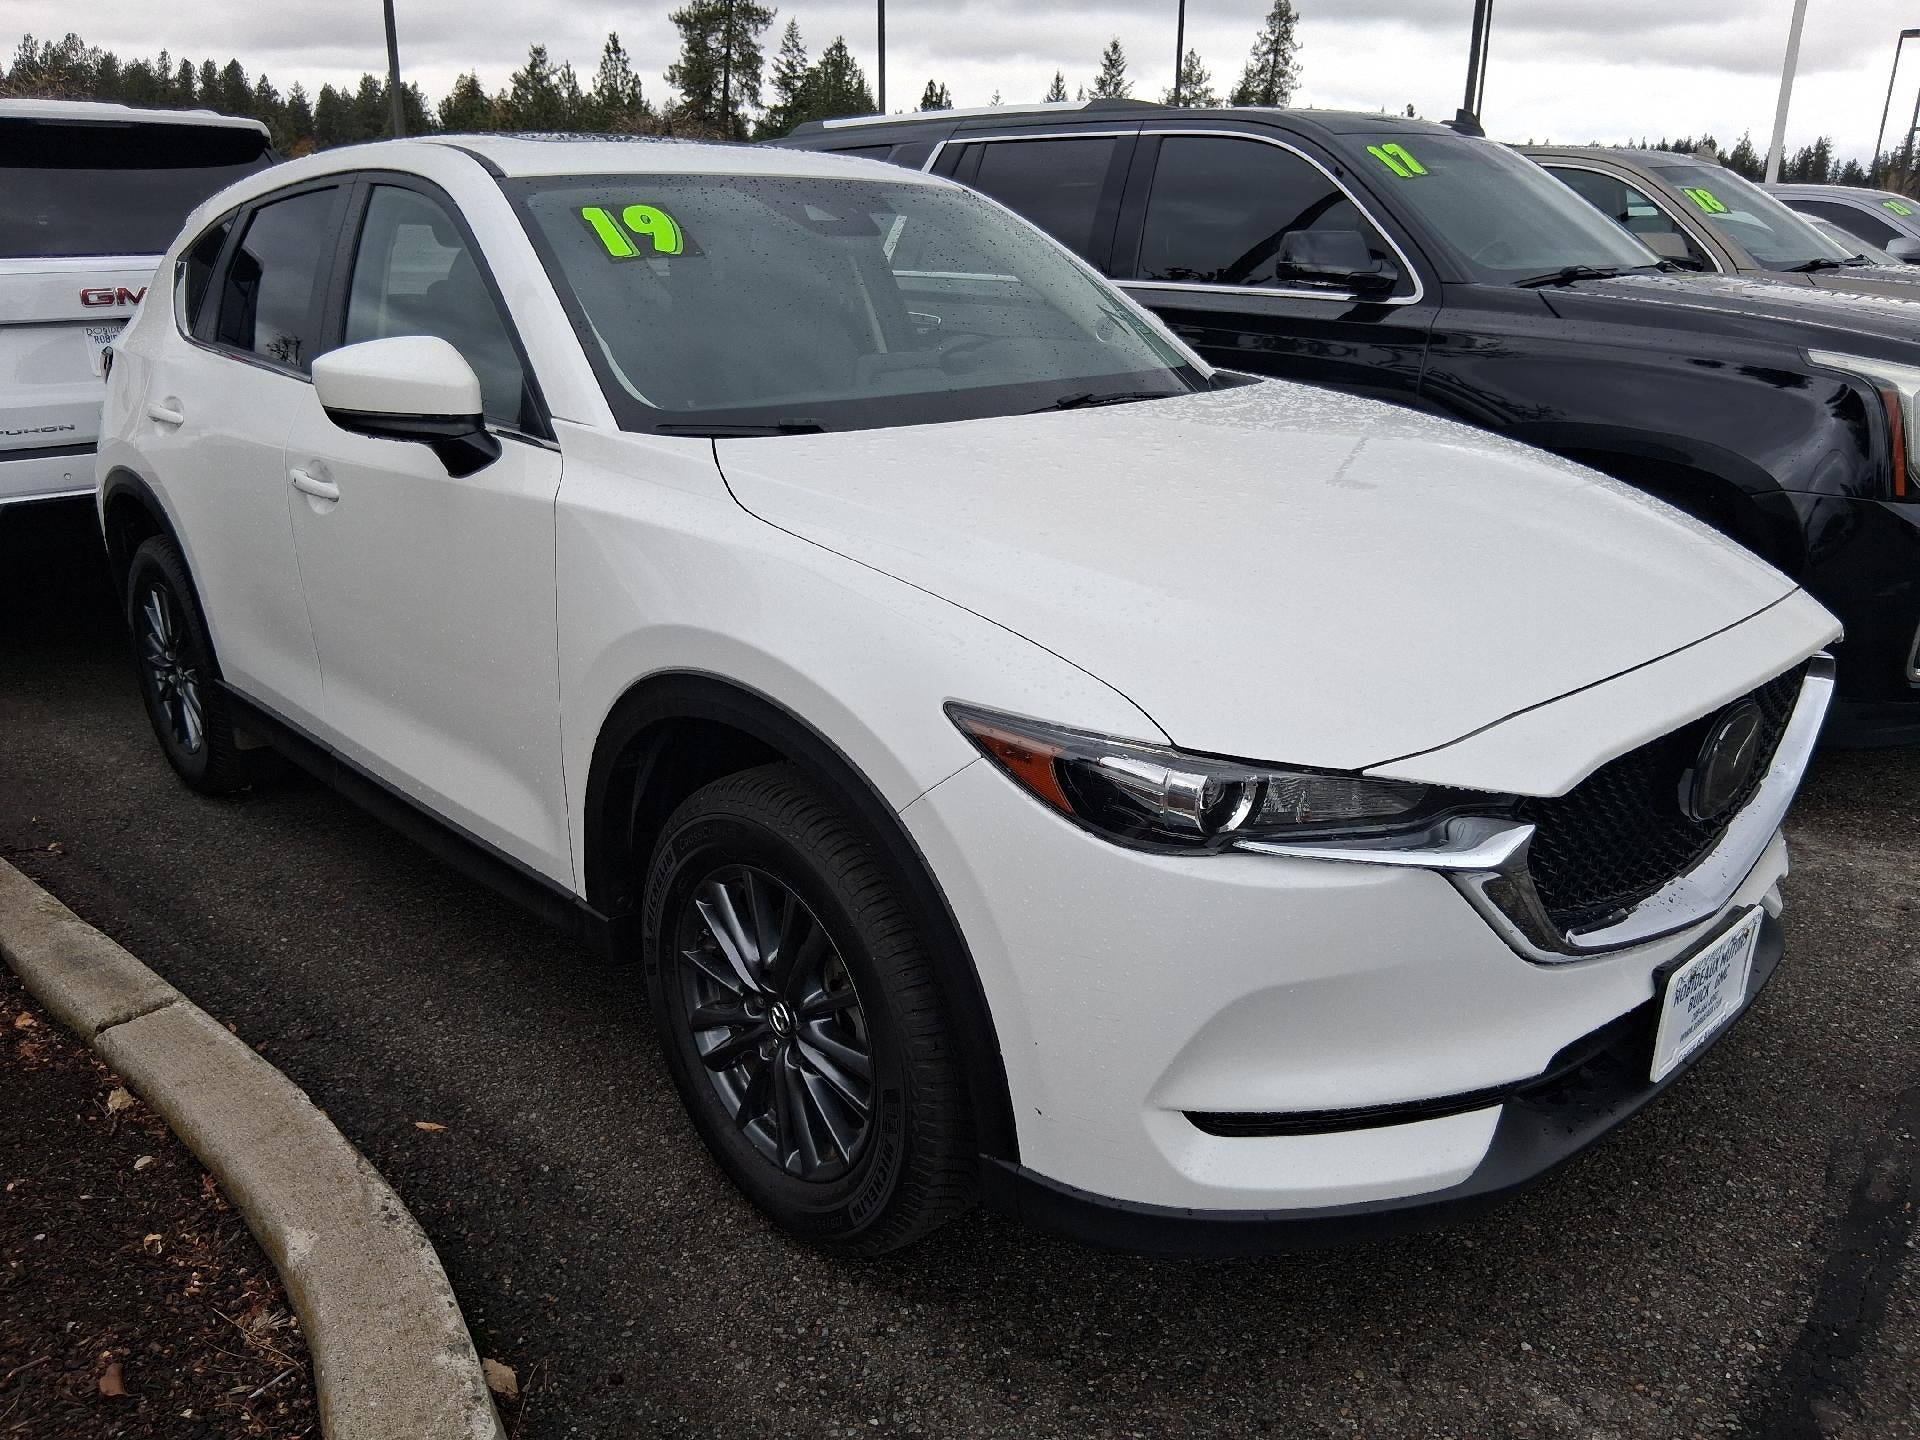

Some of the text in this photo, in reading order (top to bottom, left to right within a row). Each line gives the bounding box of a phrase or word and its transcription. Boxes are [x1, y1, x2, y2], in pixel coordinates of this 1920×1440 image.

[1366, 143, 1428, 178] 17
[1683, 188, 1728, 213] 18
[582, 204, 684, 258] 19
[1673, 957, 1721, 1009] ROBIDEAUX
[1687, 980, 1712, 1014] BUICK
[1713, 962, 1731, 990] GMC
